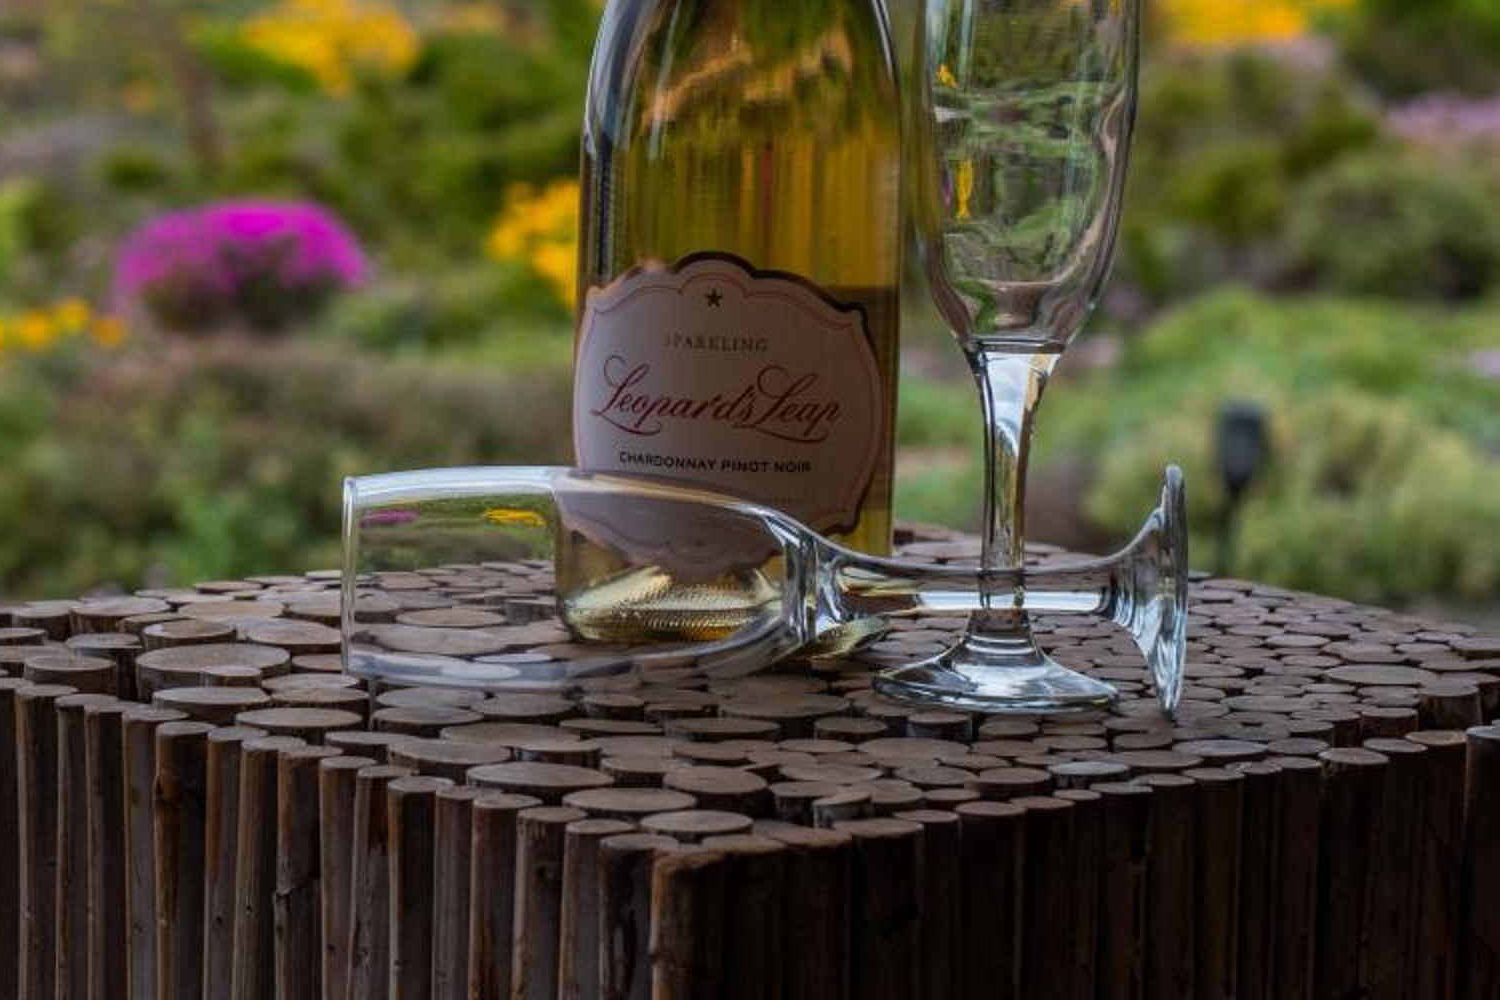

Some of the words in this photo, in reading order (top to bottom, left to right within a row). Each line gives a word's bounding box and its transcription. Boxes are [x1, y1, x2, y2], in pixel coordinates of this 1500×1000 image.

[732, 366, 842, 443] Leap
[619, 451, 718, 471] CHARDONNAY
[720, 458, 773, 473] PINOT
[774, 460, 811, 473] NOIR
